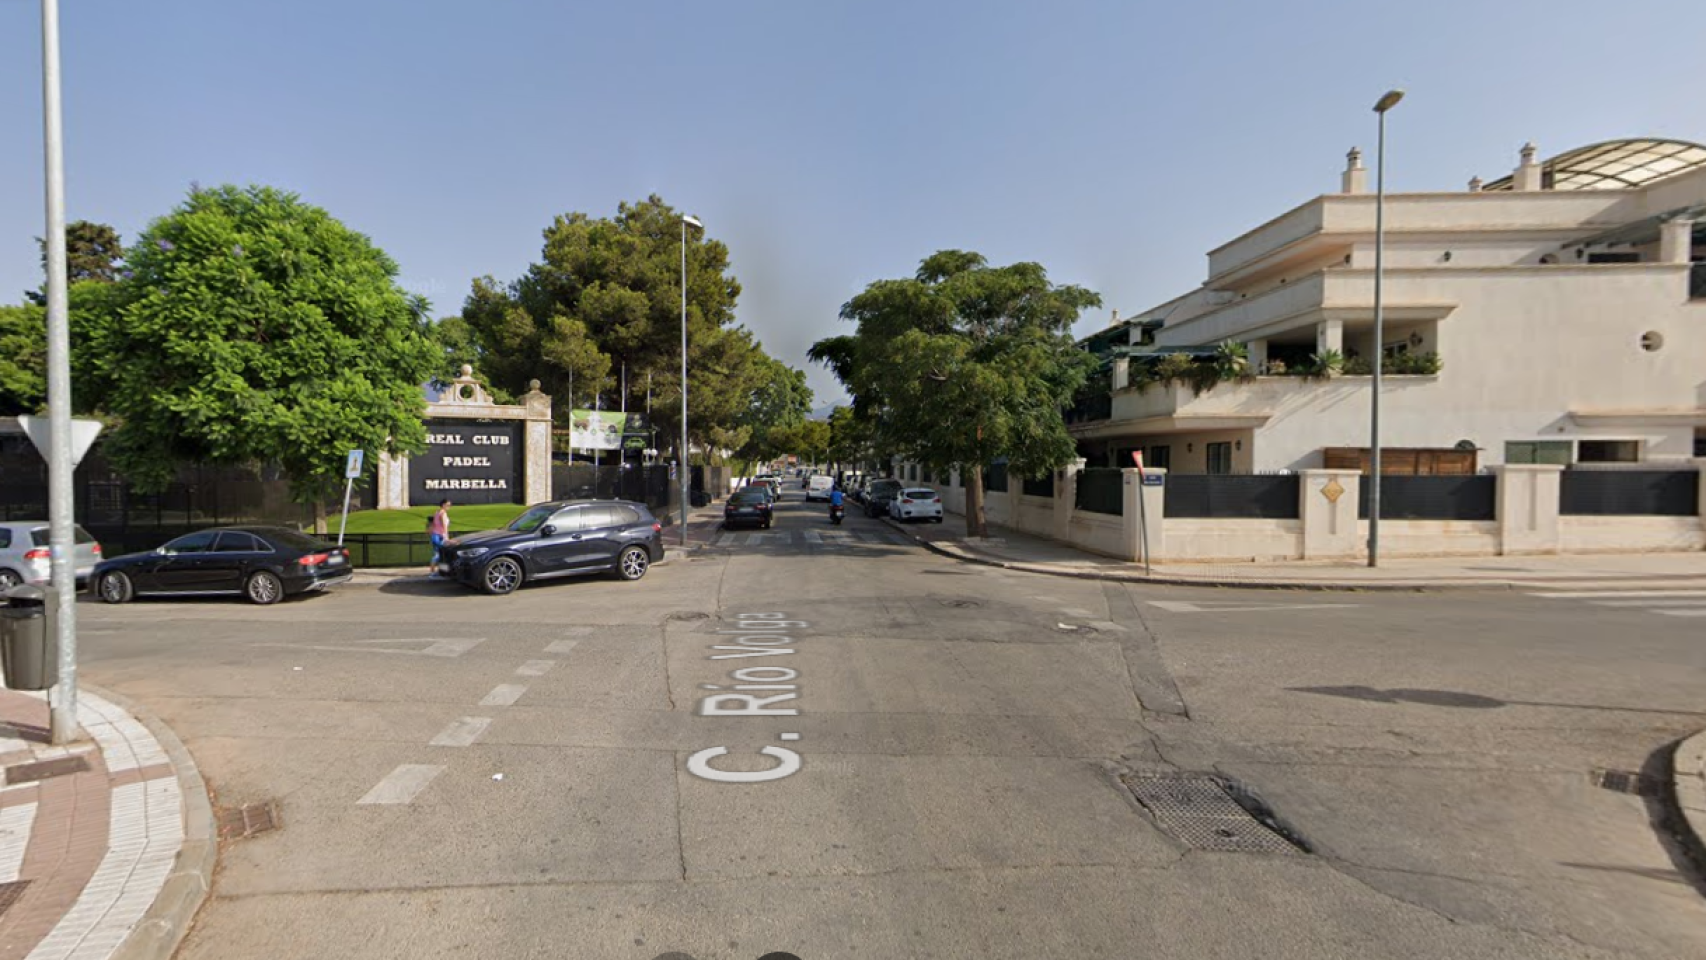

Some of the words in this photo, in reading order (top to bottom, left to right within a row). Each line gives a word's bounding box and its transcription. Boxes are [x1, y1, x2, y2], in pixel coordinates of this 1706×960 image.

[425, 434, 464, 445] REAL
[472, 435, 510, 445] CLUB
[443, 456, 491, 466] PADEL
[425, 479, 507, 489] MARBELLA
